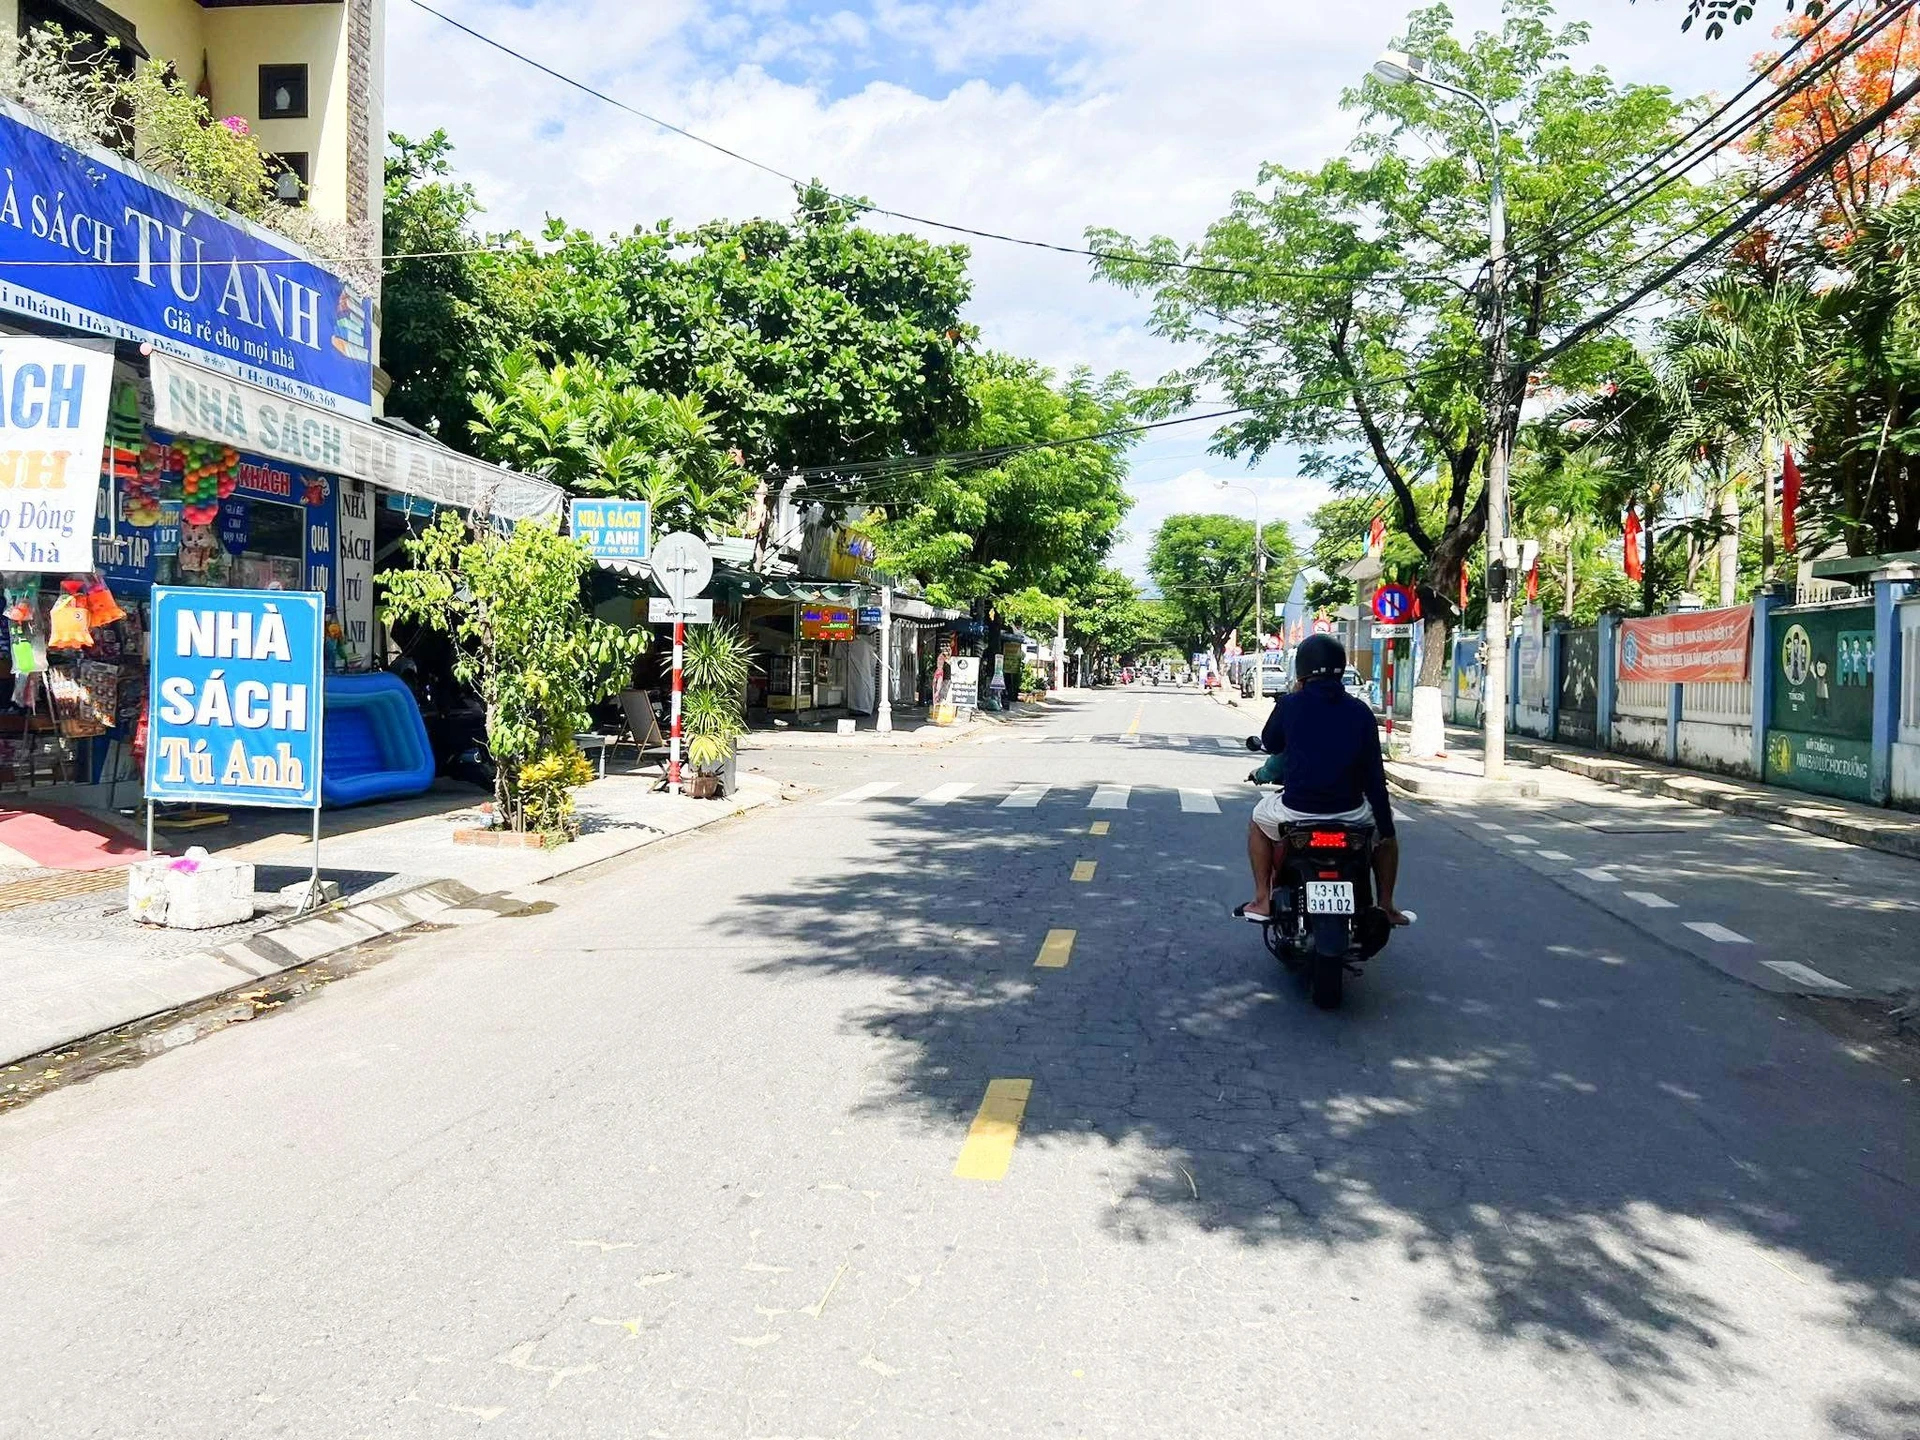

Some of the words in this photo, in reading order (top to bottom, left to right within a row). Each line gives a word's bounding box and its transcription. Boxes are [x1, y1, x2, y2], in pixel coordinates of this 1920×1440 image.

[31, 191, 117, 264] SÁCH
[124, 205, 205, 302] TÚ
[216, 255, 322, 351] ANH
[15, 295, 71, 323] nhánh
[79, 312, 112, 334] Hòa
[266, 375, 336, 409] 0346.796.368
[196, 320, 212, 342] rẻ
[214, 325, 240, 351] cho
[244, 340, 269, 365] mọi
[272, 347, 295, 371] nhà
[169, 374, 249, 442] NHÀ
[258, 404, 341, 466] SÁCH
[18, 500, 75, 538] Đông
[342, 490, 368, 520] NHÀ
[578, 504, 605, 528] NHÀ
[607, 505, 642, 529] SÁCH
[8, 541, 60, 563] Nhà
[340, 530, 372, 562] SÁCH
[604, 530, 640, 546] ANH
[346, 572, 363, 602] TÚ
[175, 602, 292, 662] NHÀ
[160, 668, 308, 732] SÁCH
[159, 736, 216, 786] Tú
[220, 738, 305, 790] Anh
[1310, 898, 1352, 912] 381.02
